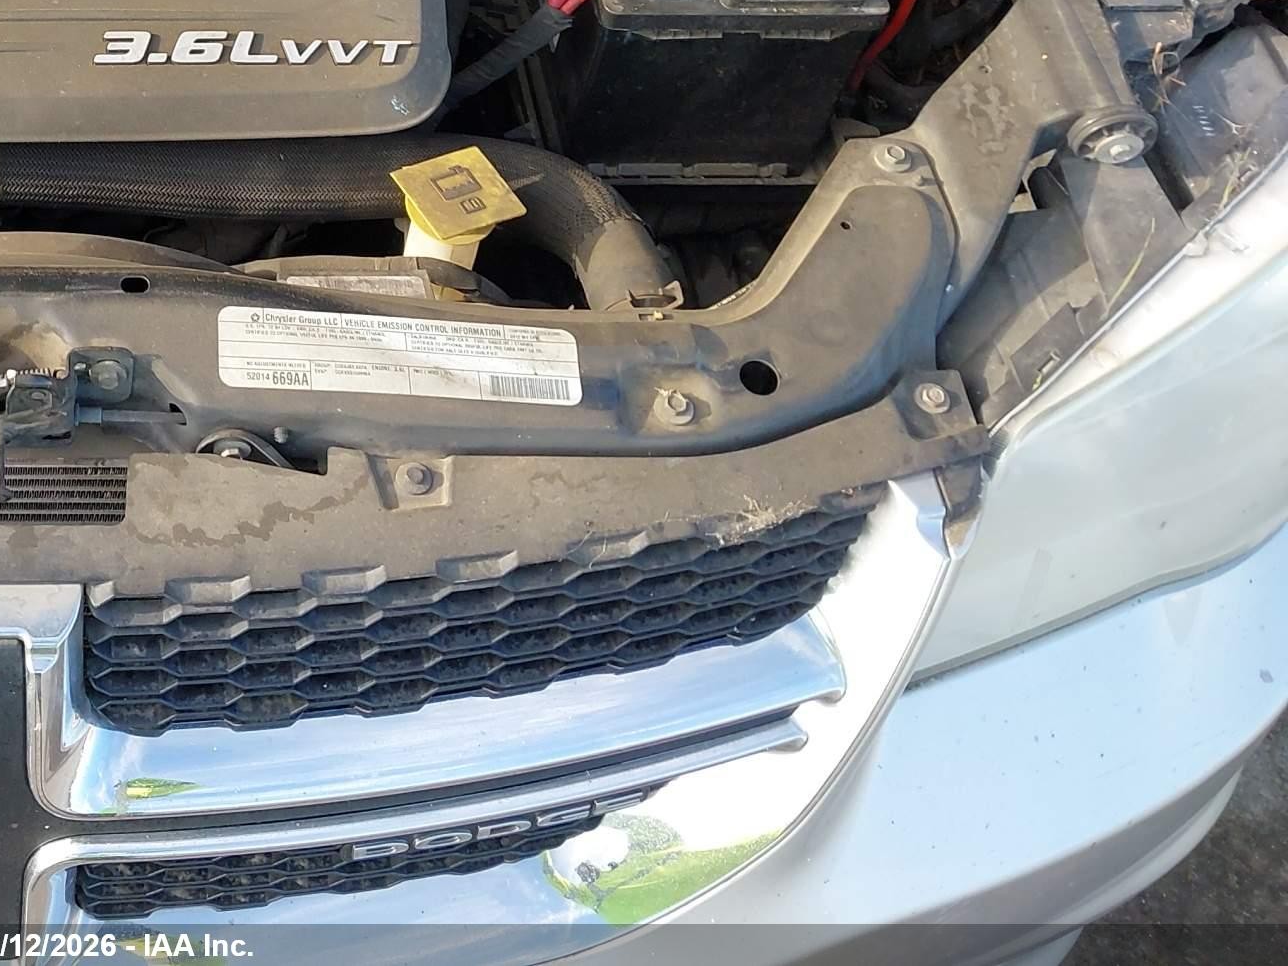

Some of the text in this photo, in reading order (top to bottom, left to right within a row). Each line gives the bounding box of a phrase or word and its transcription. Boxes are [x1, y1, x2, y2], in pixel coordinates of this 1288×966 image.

[265, 313, 296, 325] Chrysler
[298, 315, 322, 326] Group
[324, 317, 338, 326] LLC
[344, 319, 375, 329] VEHICLE
[377, 320, 413, 332] EMISSION
[415, 323, 449, 334] CONTROL
[451, 325, 502, 337] INFORMATION
[246, 372, 270, 381] 52014
[272, 372, 309, 387] 669AA
[353, 790, 645, 860] DODGE
